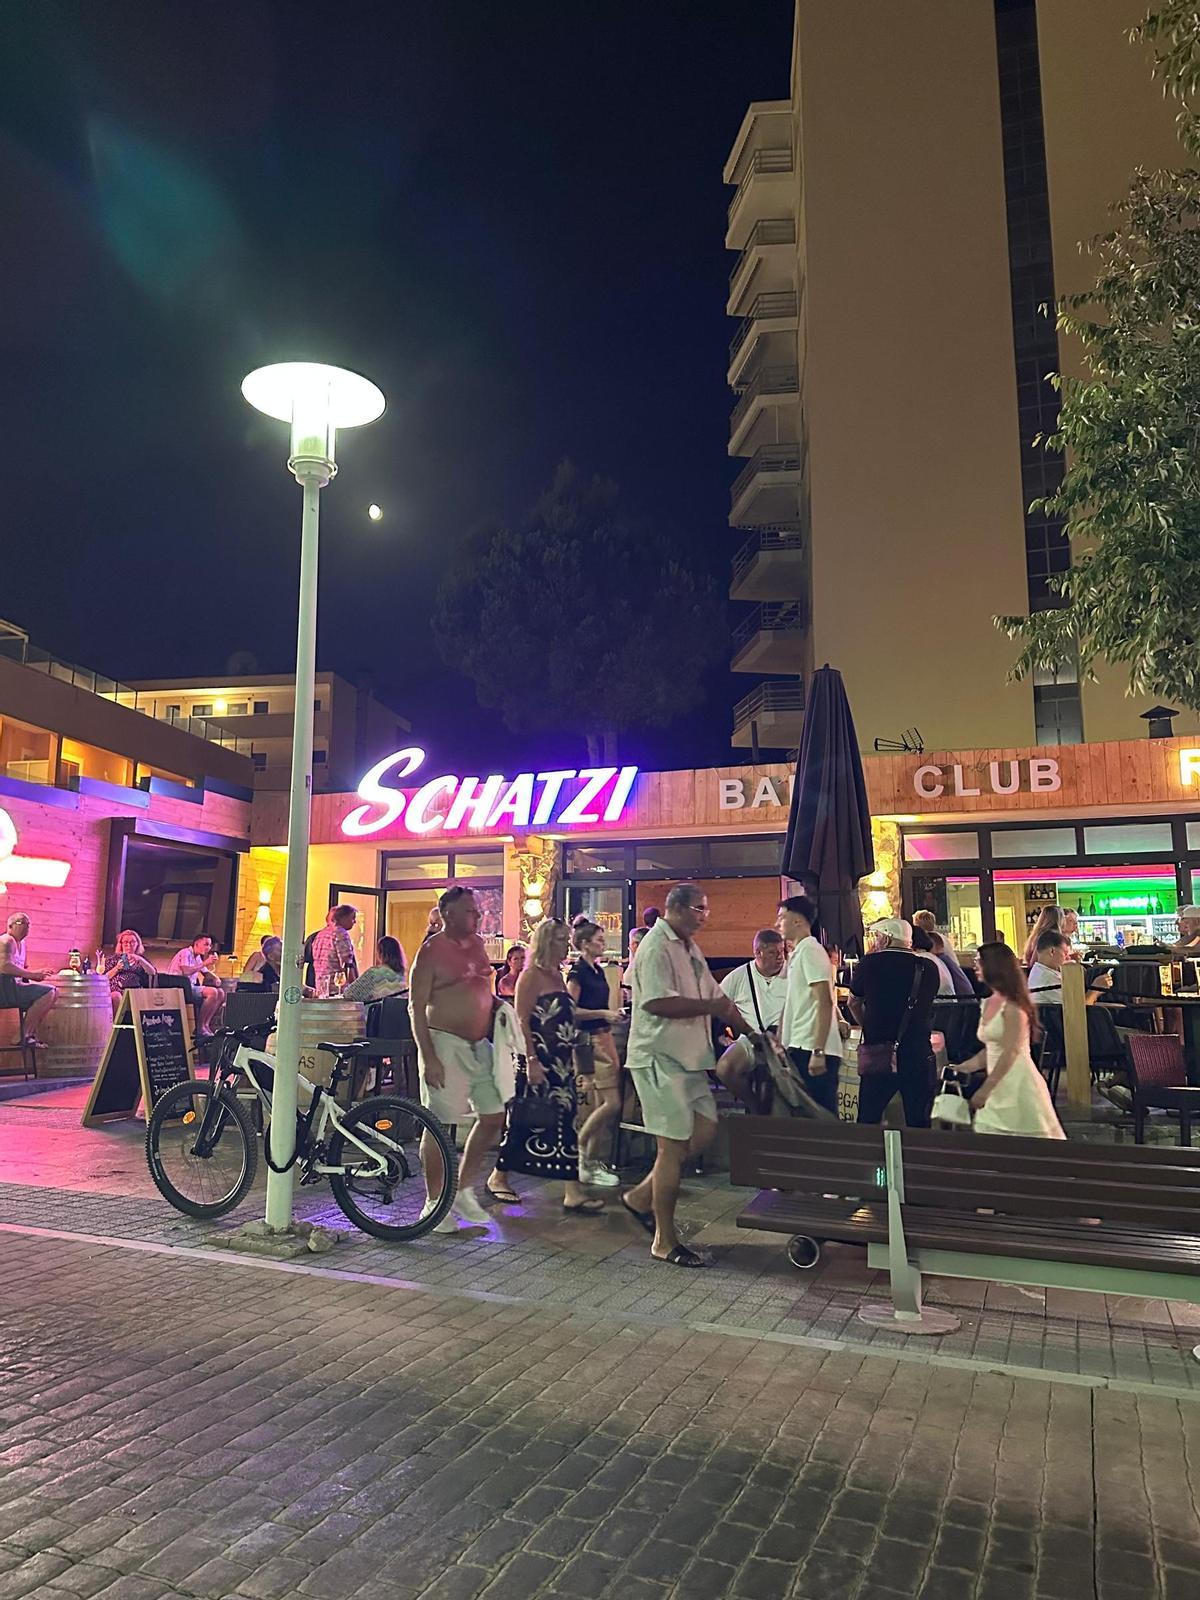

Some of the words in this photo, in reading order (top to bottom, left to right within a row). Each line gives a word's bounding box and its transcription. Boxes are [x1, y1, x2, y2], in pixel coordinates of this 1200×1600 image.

[341, 746, 639, 836] SCHATZI
[719, 774, 796, 810] BA
[913, 758, 1062, 799] CLUB
